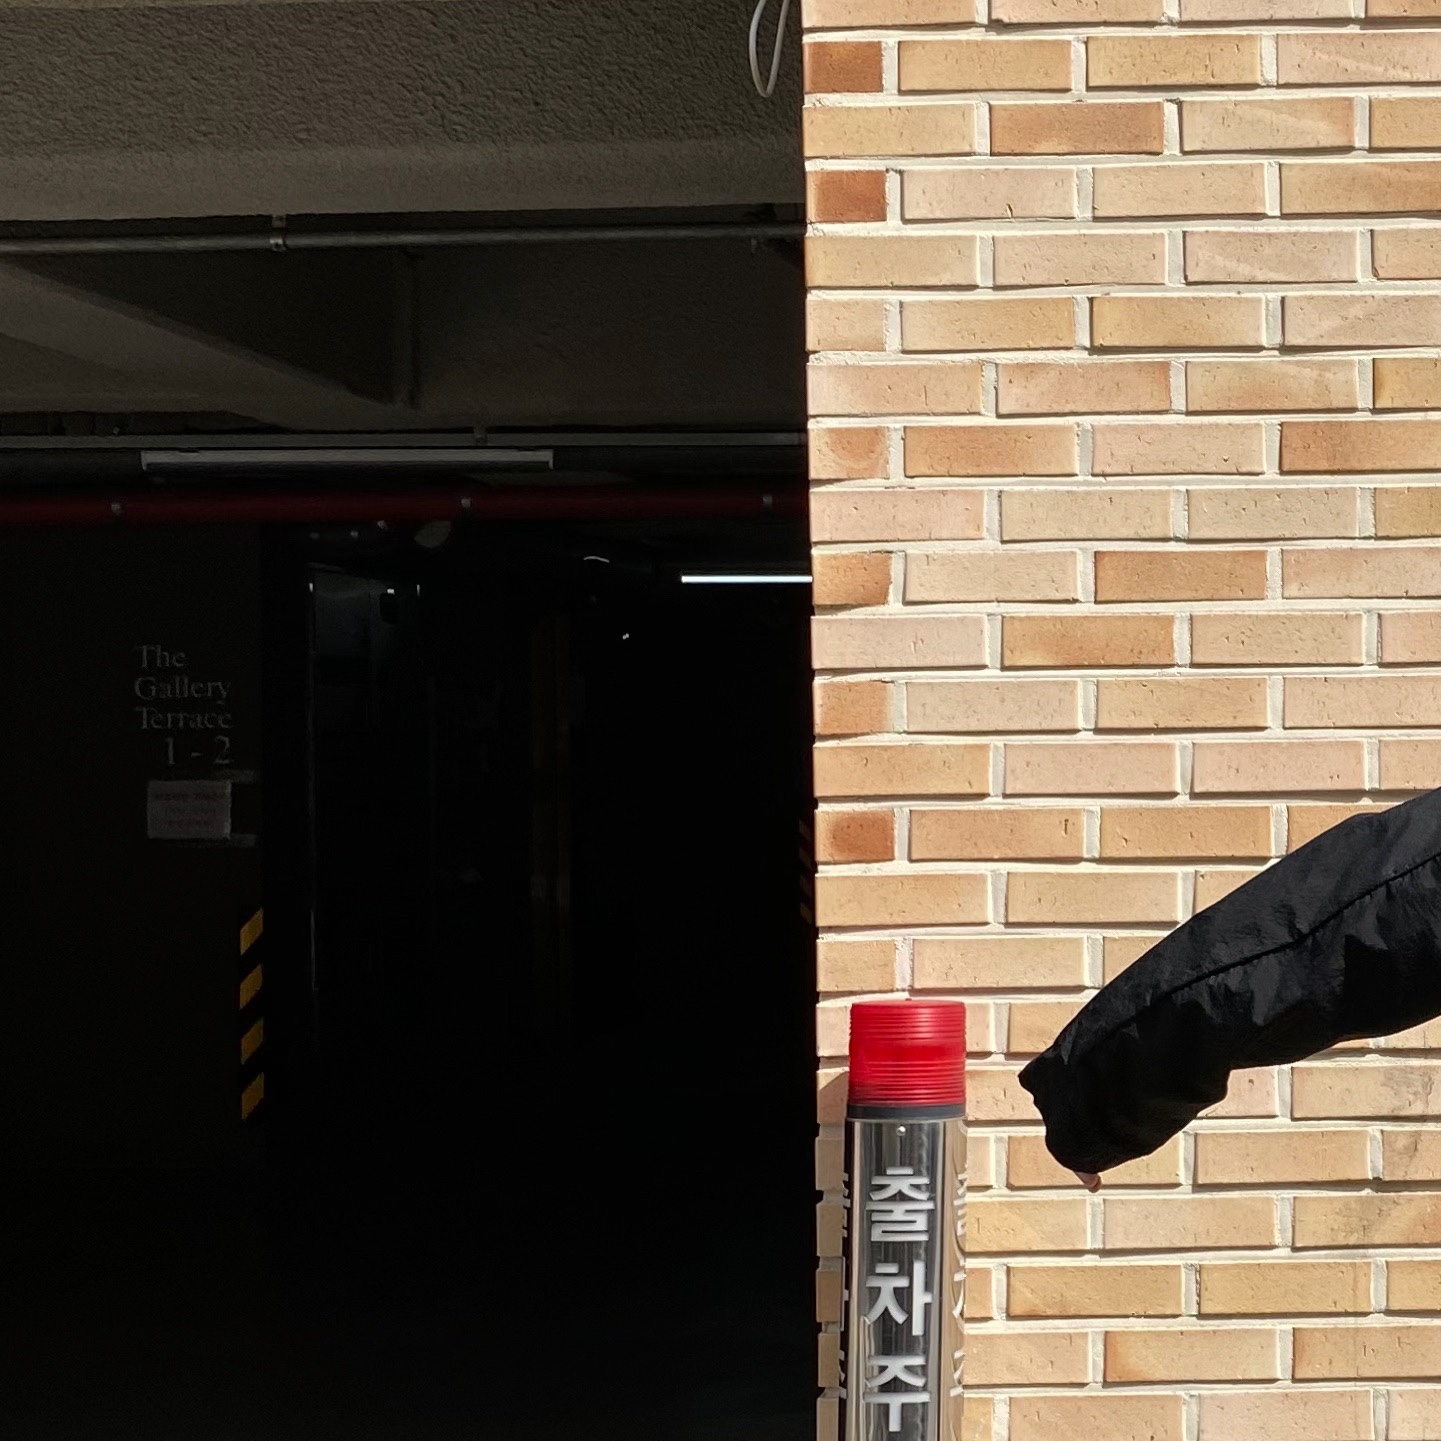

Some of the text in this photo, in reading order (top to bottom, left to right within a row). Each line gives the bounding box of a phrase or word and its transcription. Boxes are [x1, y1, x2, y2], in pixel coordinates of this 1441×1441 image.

[134, 643, 188, 668] The
[133, 675, 231, 705] Gallery
[134, 706, 234, 729] Terrace
